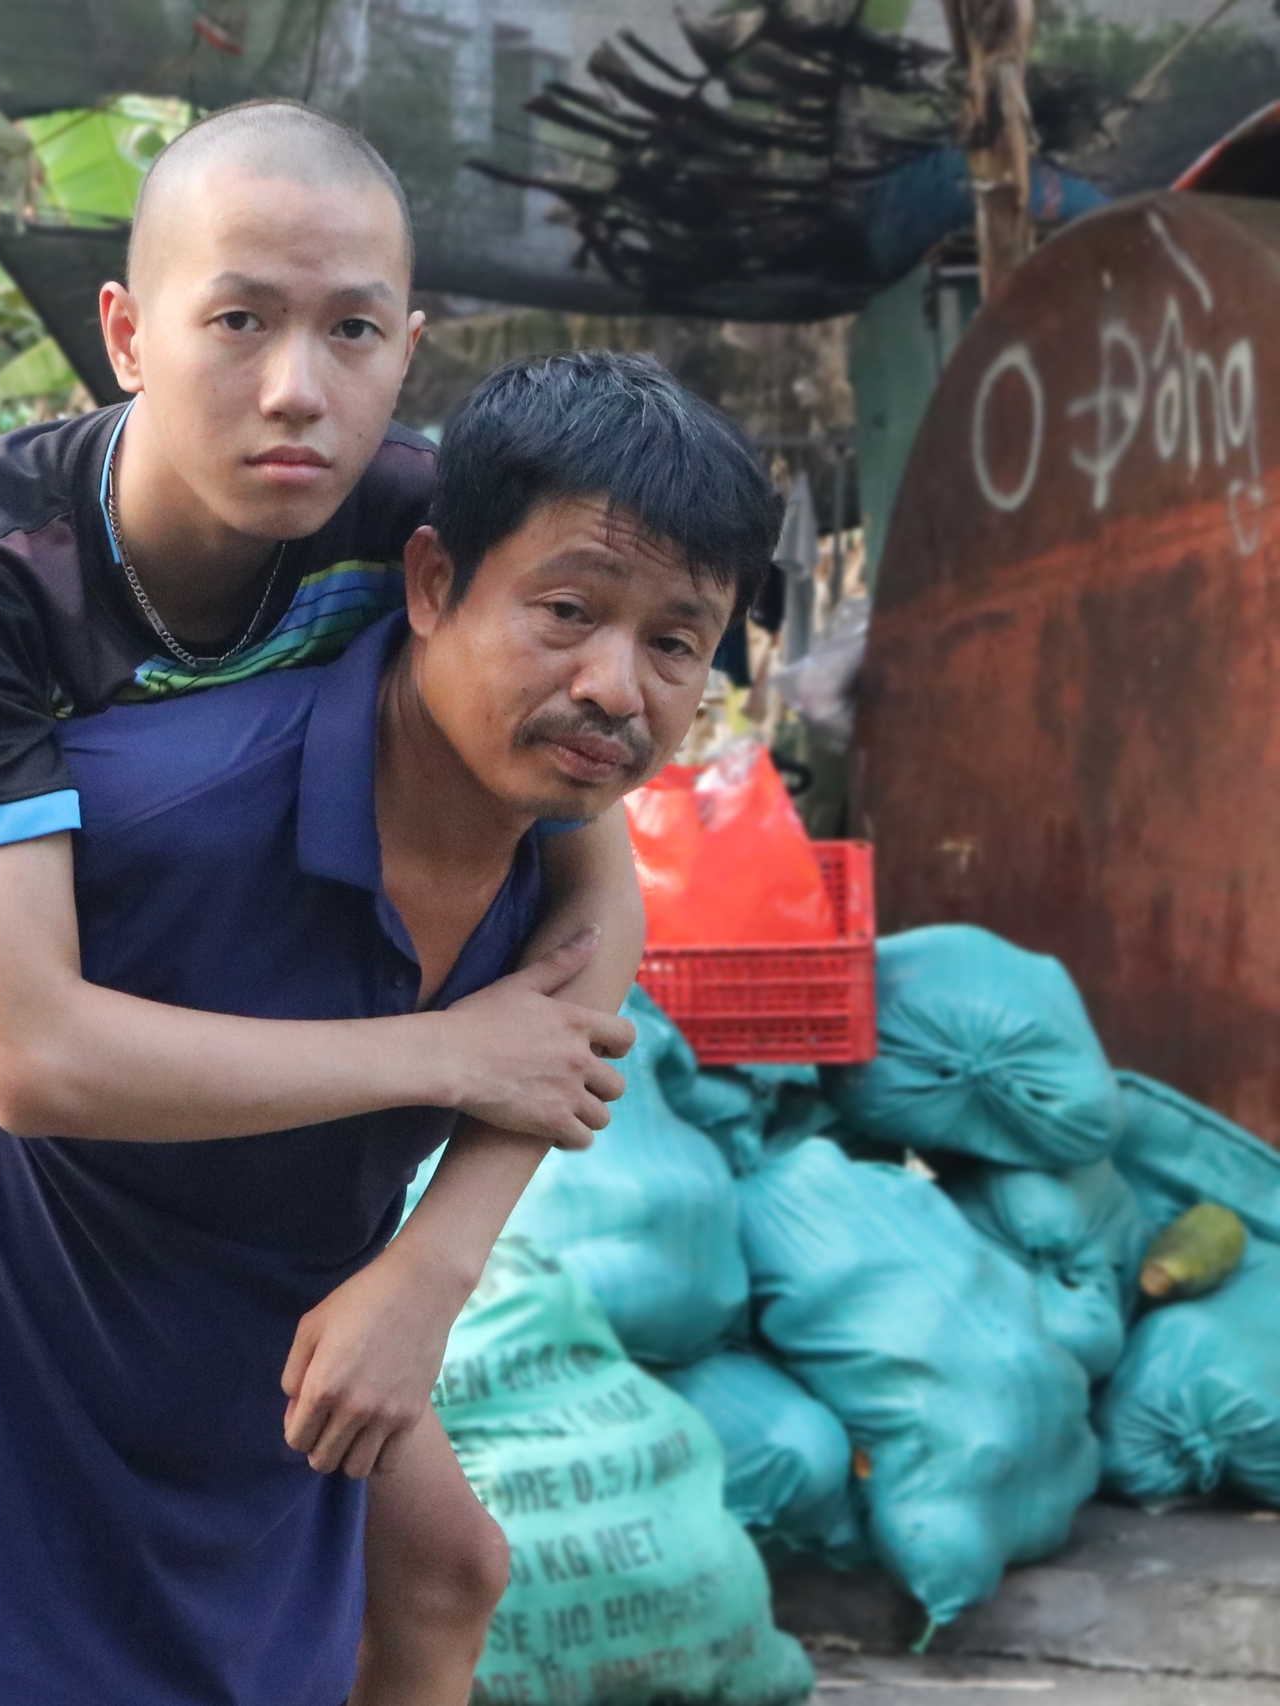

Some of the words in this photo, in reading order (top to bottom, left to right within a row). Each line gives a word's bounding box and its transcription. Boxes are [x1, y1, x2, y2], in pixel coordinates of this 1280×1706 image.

[478, 1466, 562, 1518] URE
[534, 1533, 592, 1585] KG
[594, 1519, 665, 1575] NET
[488, 1610, 531, 1654] SE
[542, 1603, 593, 1650] NO
